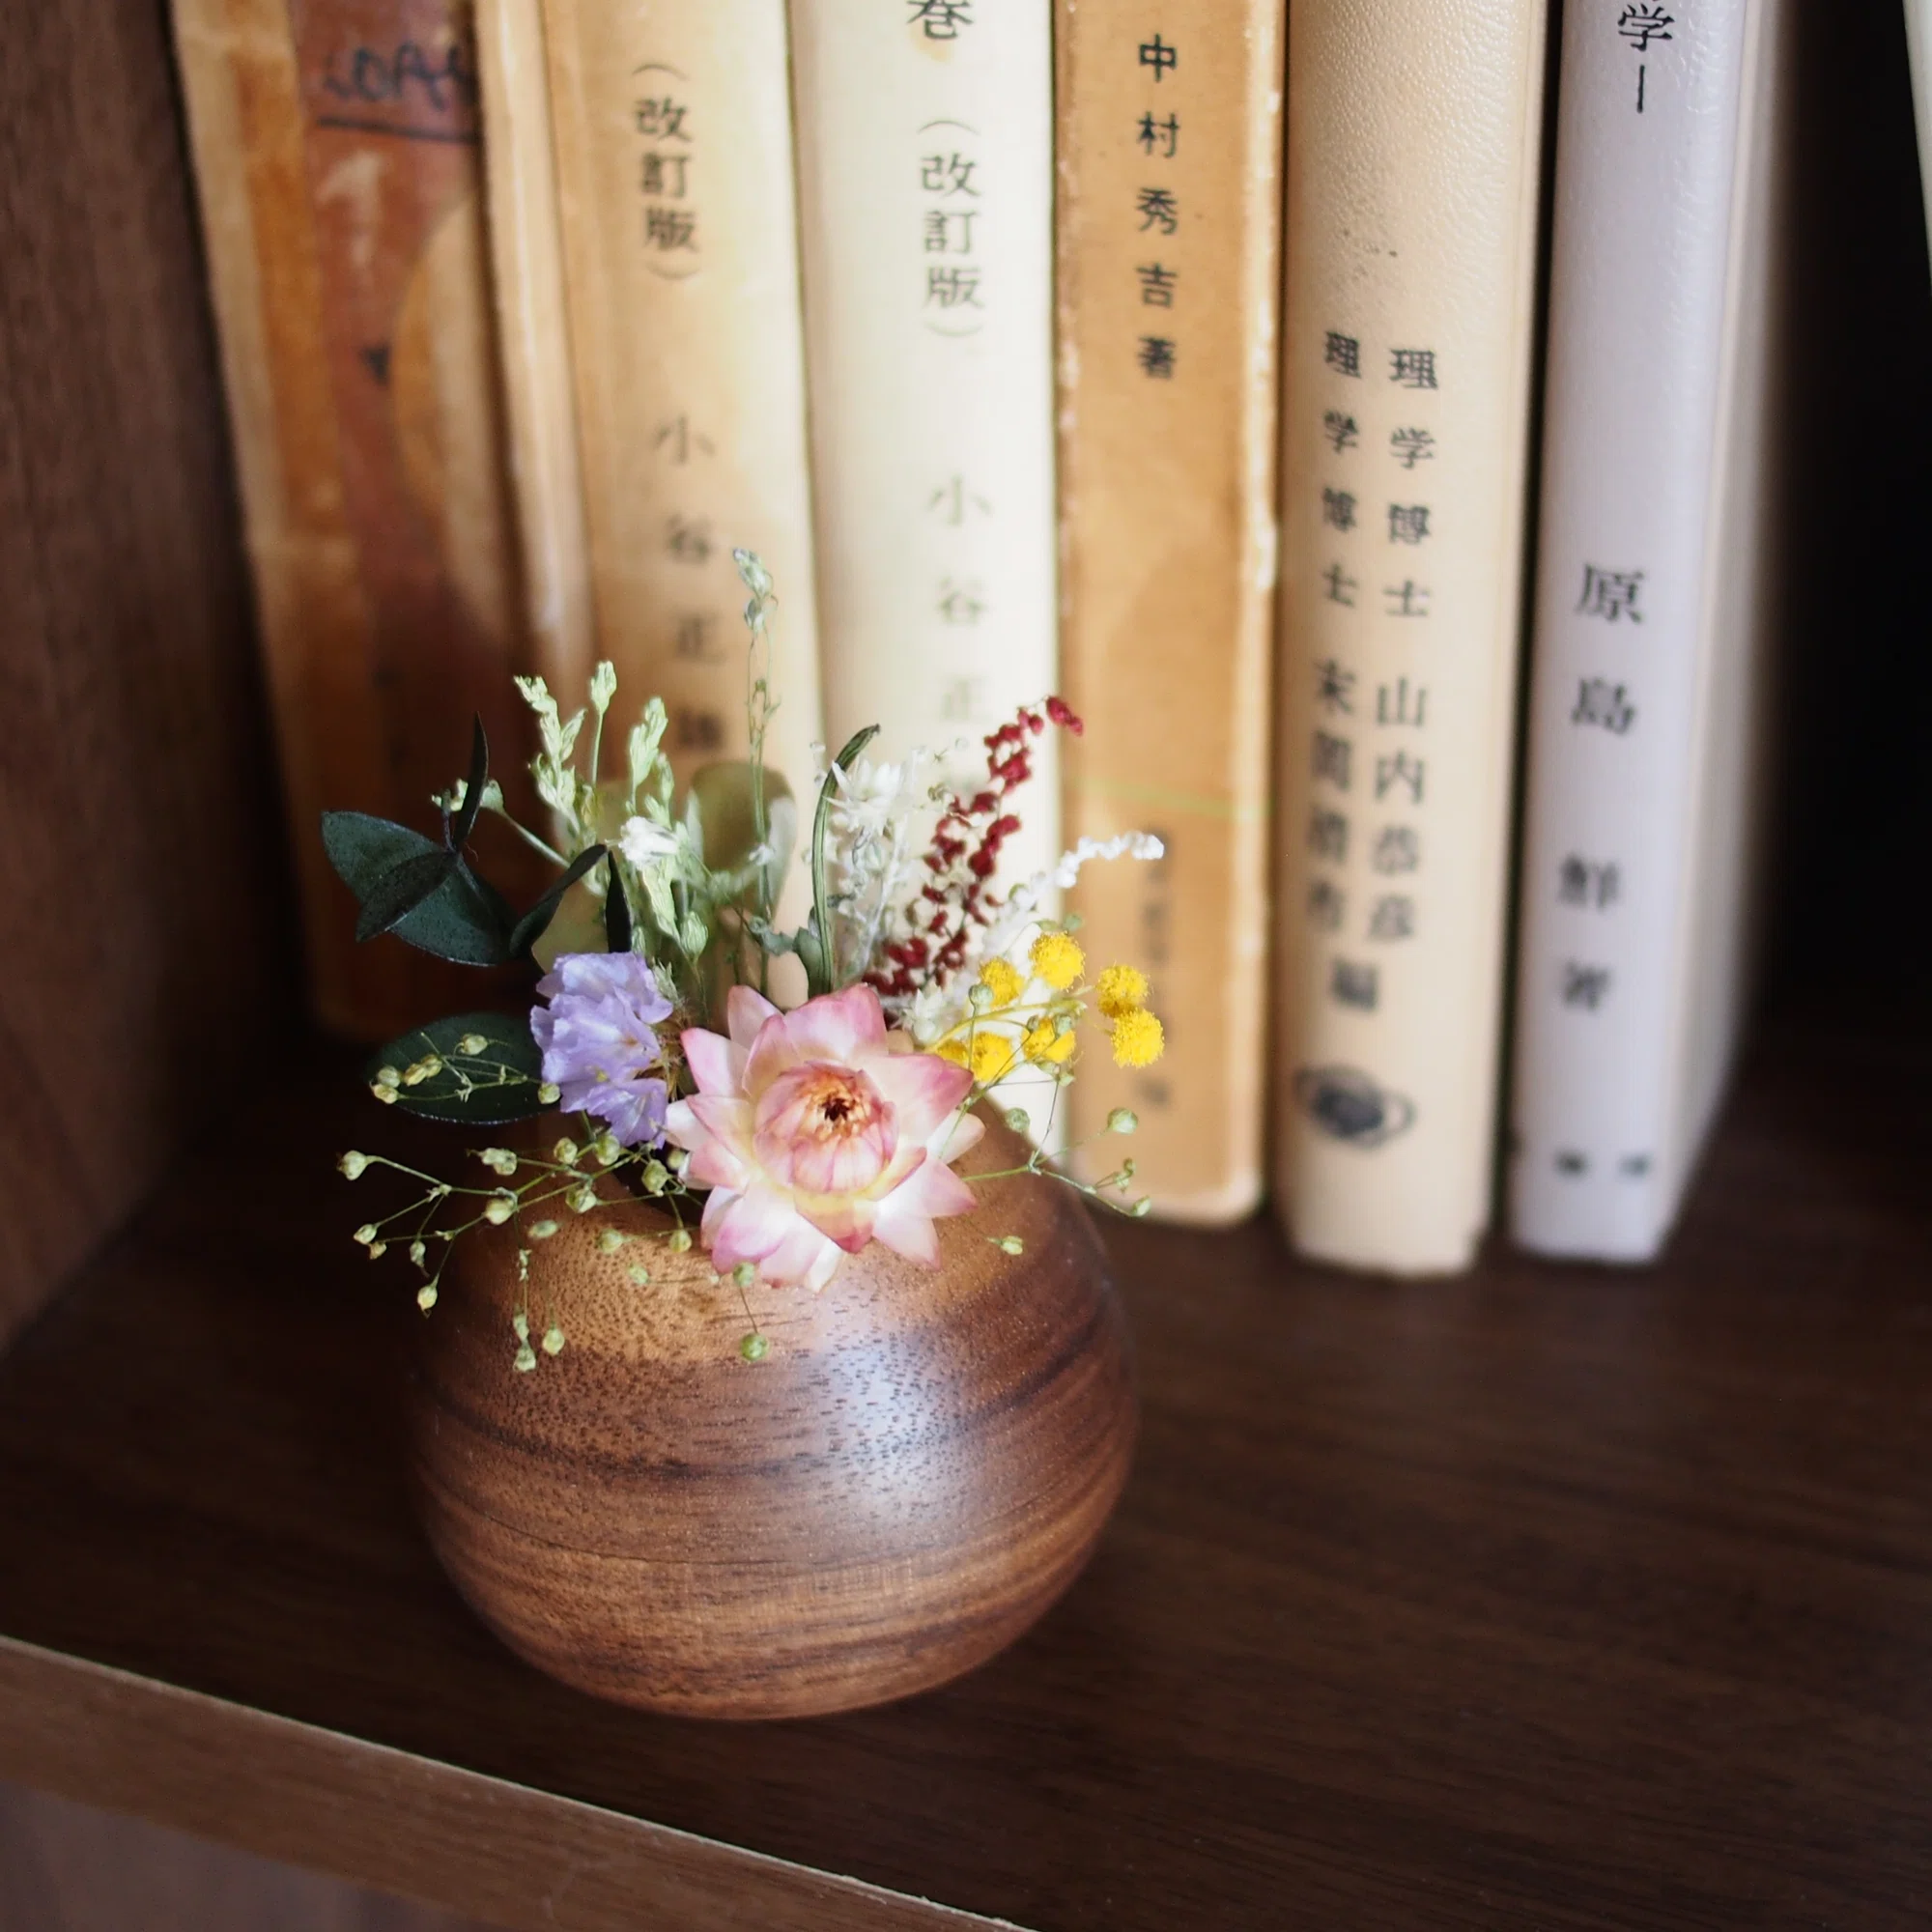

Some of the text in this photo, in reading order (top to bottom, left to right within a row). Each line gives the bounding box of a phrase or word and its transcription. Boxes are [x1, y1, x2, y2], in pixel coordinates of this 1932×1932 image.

[917, 118, 985, 339] （改訂版）
[1135, 33, 1180, 382] 中村秀吉著
[1383, 348, 1438, 619] 理学博士
